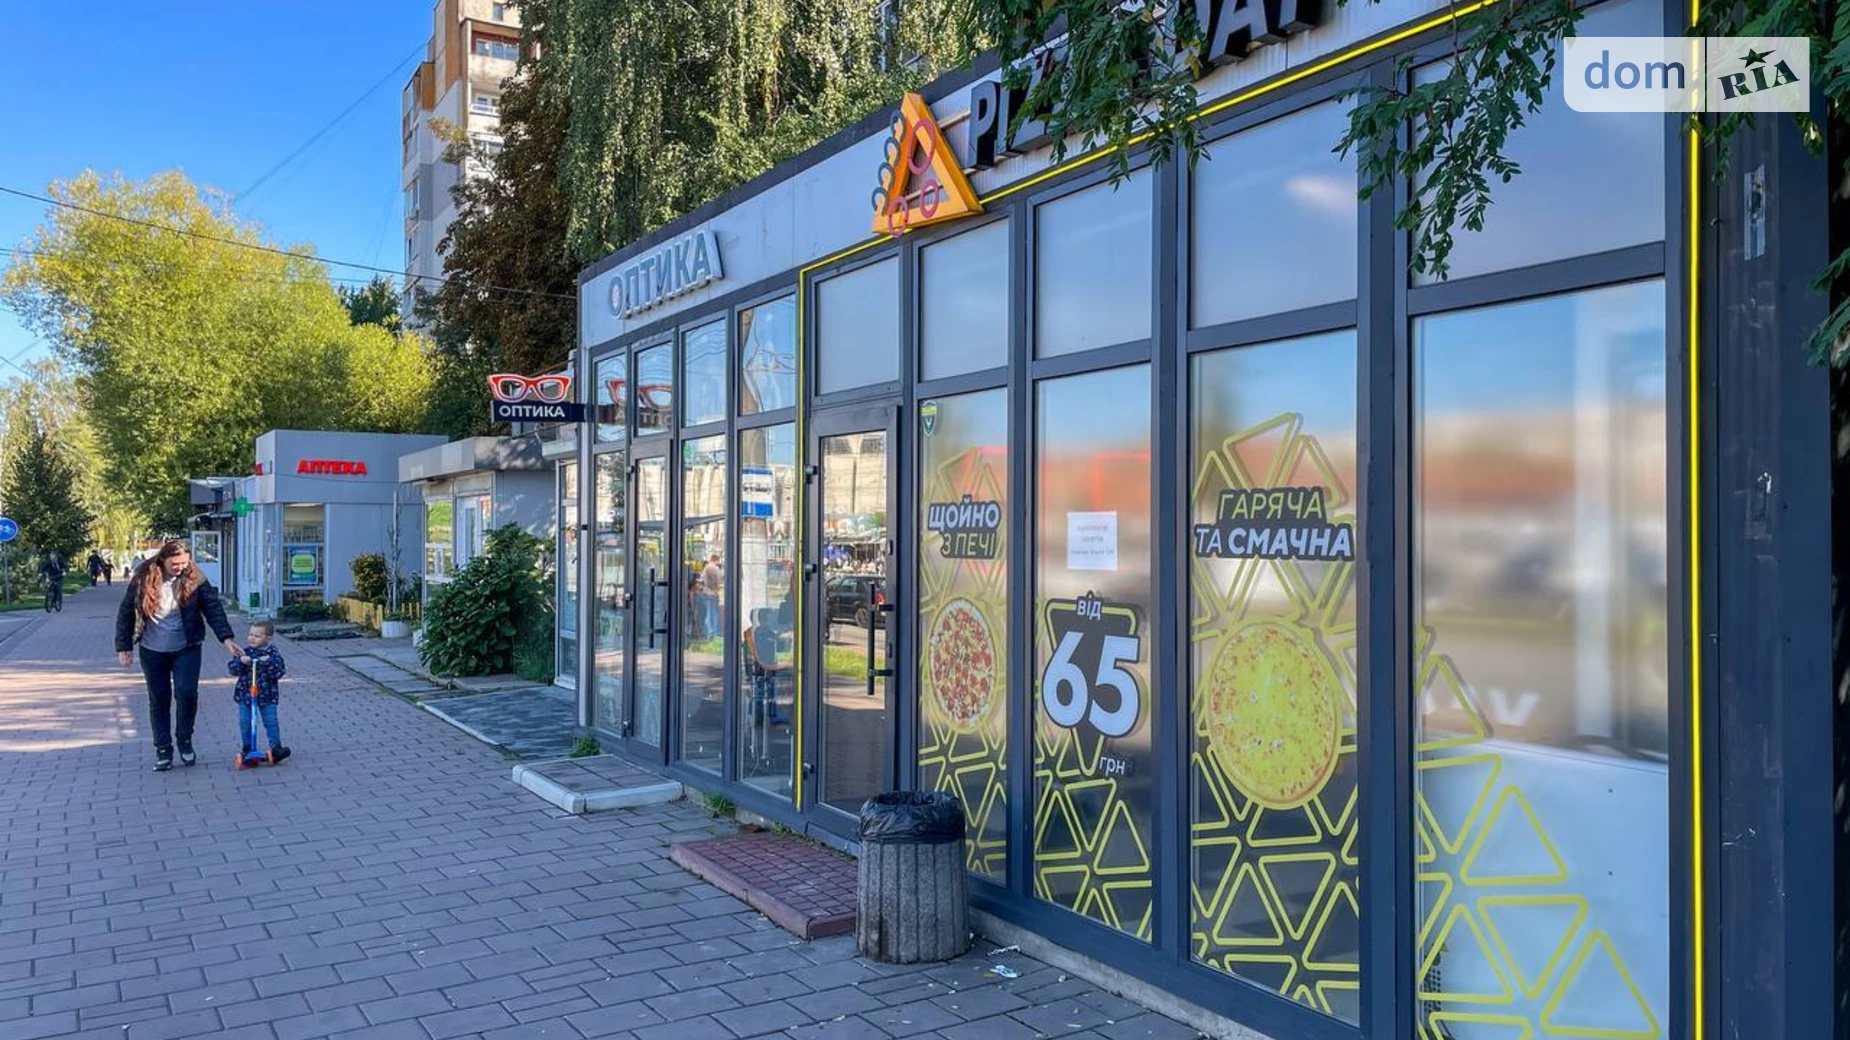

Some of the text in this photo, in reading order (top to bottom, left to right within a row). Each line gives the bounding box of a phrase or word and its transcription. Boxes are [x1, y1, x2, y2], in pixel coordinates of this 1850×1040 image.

[608, 230, 712, 319] ОПТИКА
[499, 404, 565, 418] ОПТИКА
[296, 459, 368, 475] АПТЕКА
[928, 496, 1000, 532] ЩОЙНО
[1219, 491, 1323, 520] ГАРЯЧА
[941, 532, 995, 556] З ПЕЧІ
[1196, 527, 1352, 557] ТА СМАЧНА
[1042, 631, 1140, 737] 65
[1099, 757, 1126, 776] грн
